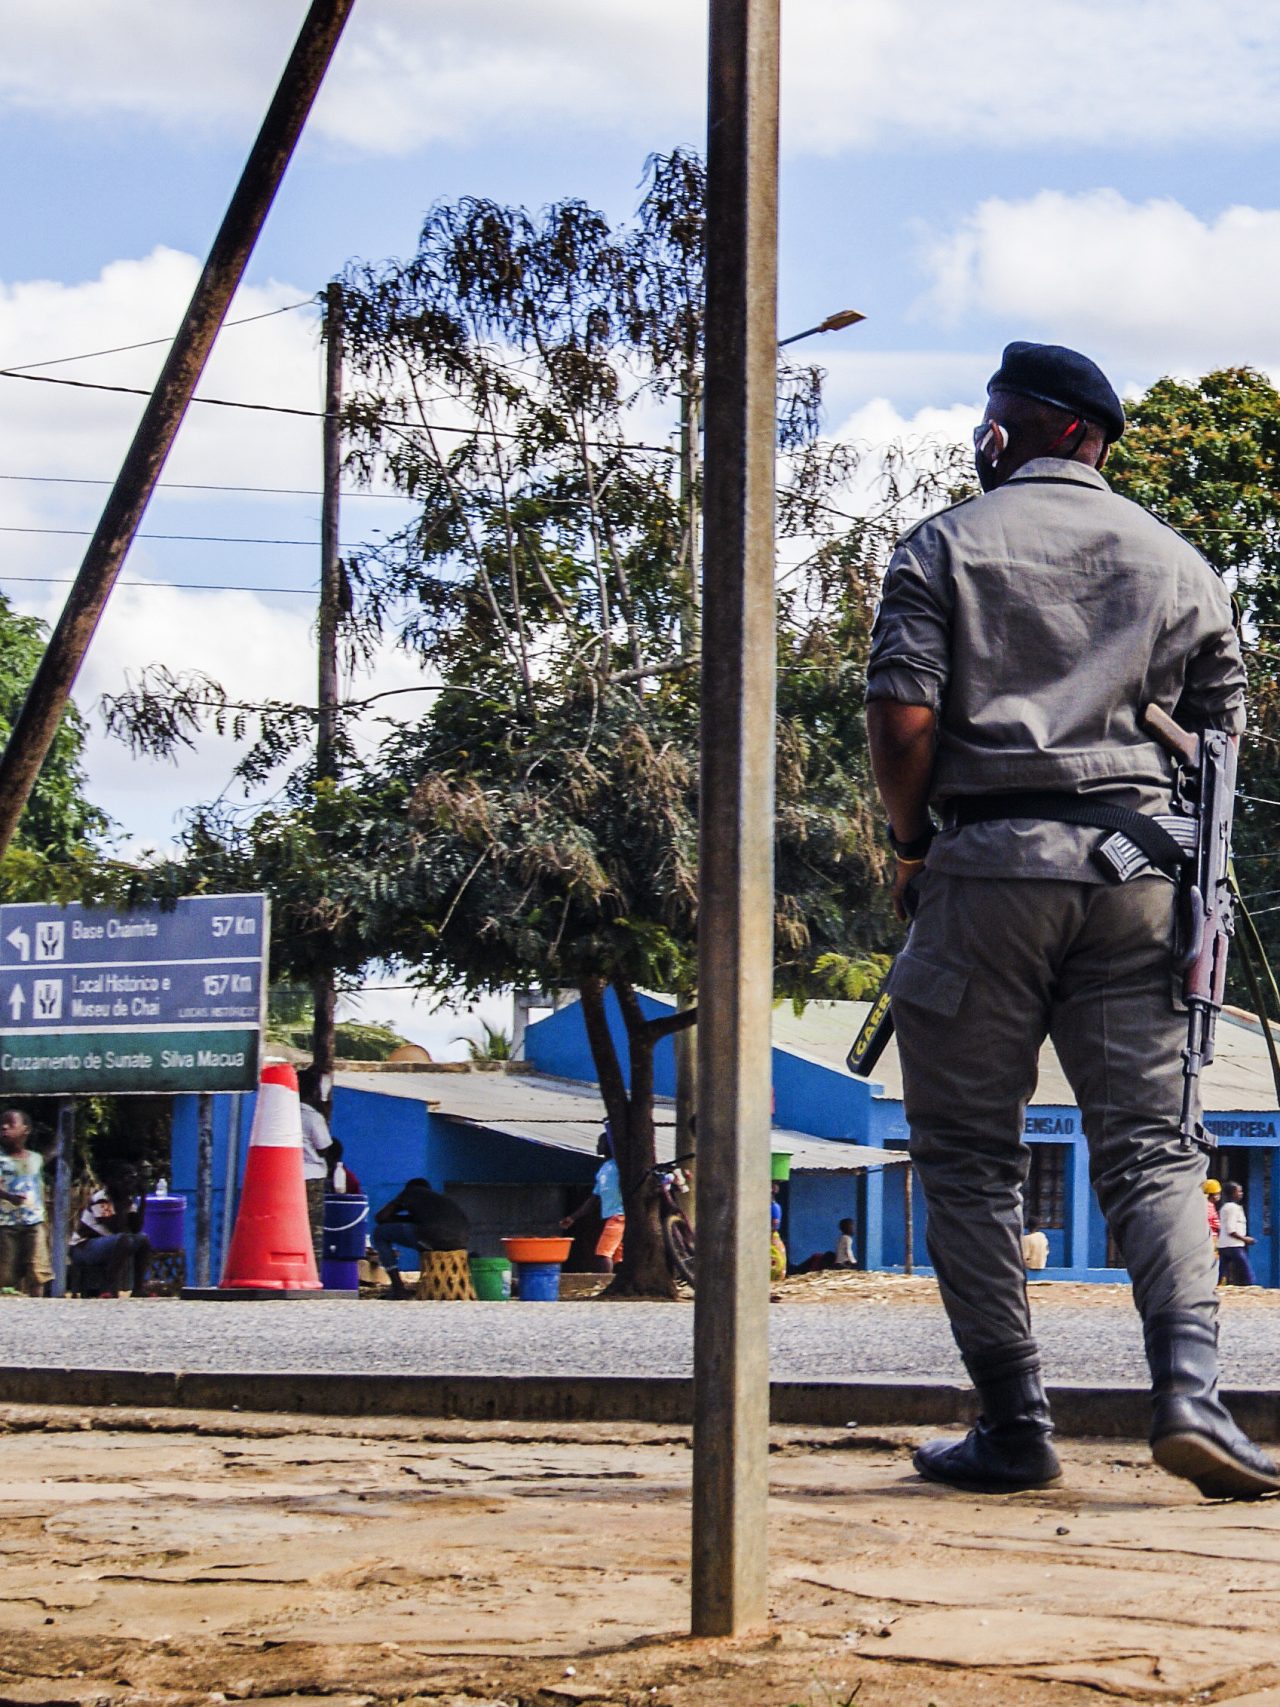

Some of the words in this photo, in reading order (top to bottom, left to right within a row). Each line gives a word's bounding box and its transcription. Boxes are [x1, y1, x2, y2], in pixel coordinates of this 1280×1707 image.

[72, 920, 104, 939] Base
[211, 916, 234, 937] 57
[235, 916, 256, 934] Km
[72, 974, 104, 993] Local
[162, 978, 171, 991] e
[203, 975, 230, 995] 157
[231, 974, 252, 992] Km
[72, 998, 110, 1017] Museu
[112, 998, 128, 1016] de
[131, 996, 160, 1016] Chai
[2, 1053, 80, 1071] Cruzamento
[83, 1052, 101, 1069] de
[160, 1050, 194, 1068] Silva
[197, 1051, 244, 1067] Macua
